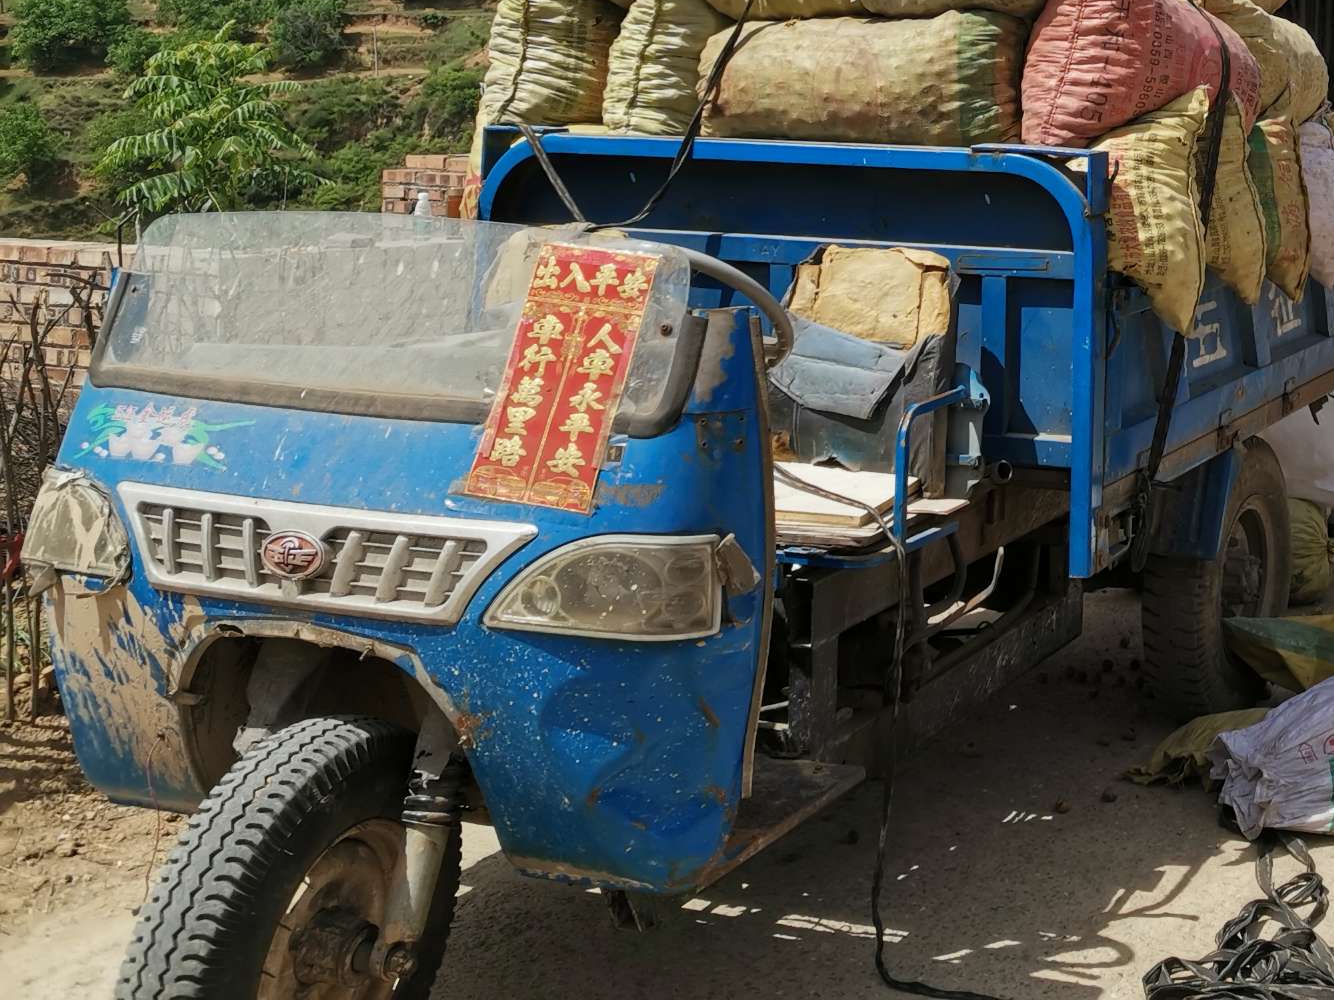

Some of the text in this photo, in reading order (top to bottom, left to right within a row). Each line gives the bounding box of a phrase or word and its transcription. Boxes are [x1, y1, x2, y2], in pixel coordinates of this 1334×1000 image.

[533, 256, 648, 297] 出入平安
[489, 314, 565, 467] 車行萬里路
[546, 322, 623, 477] 人車永平安
